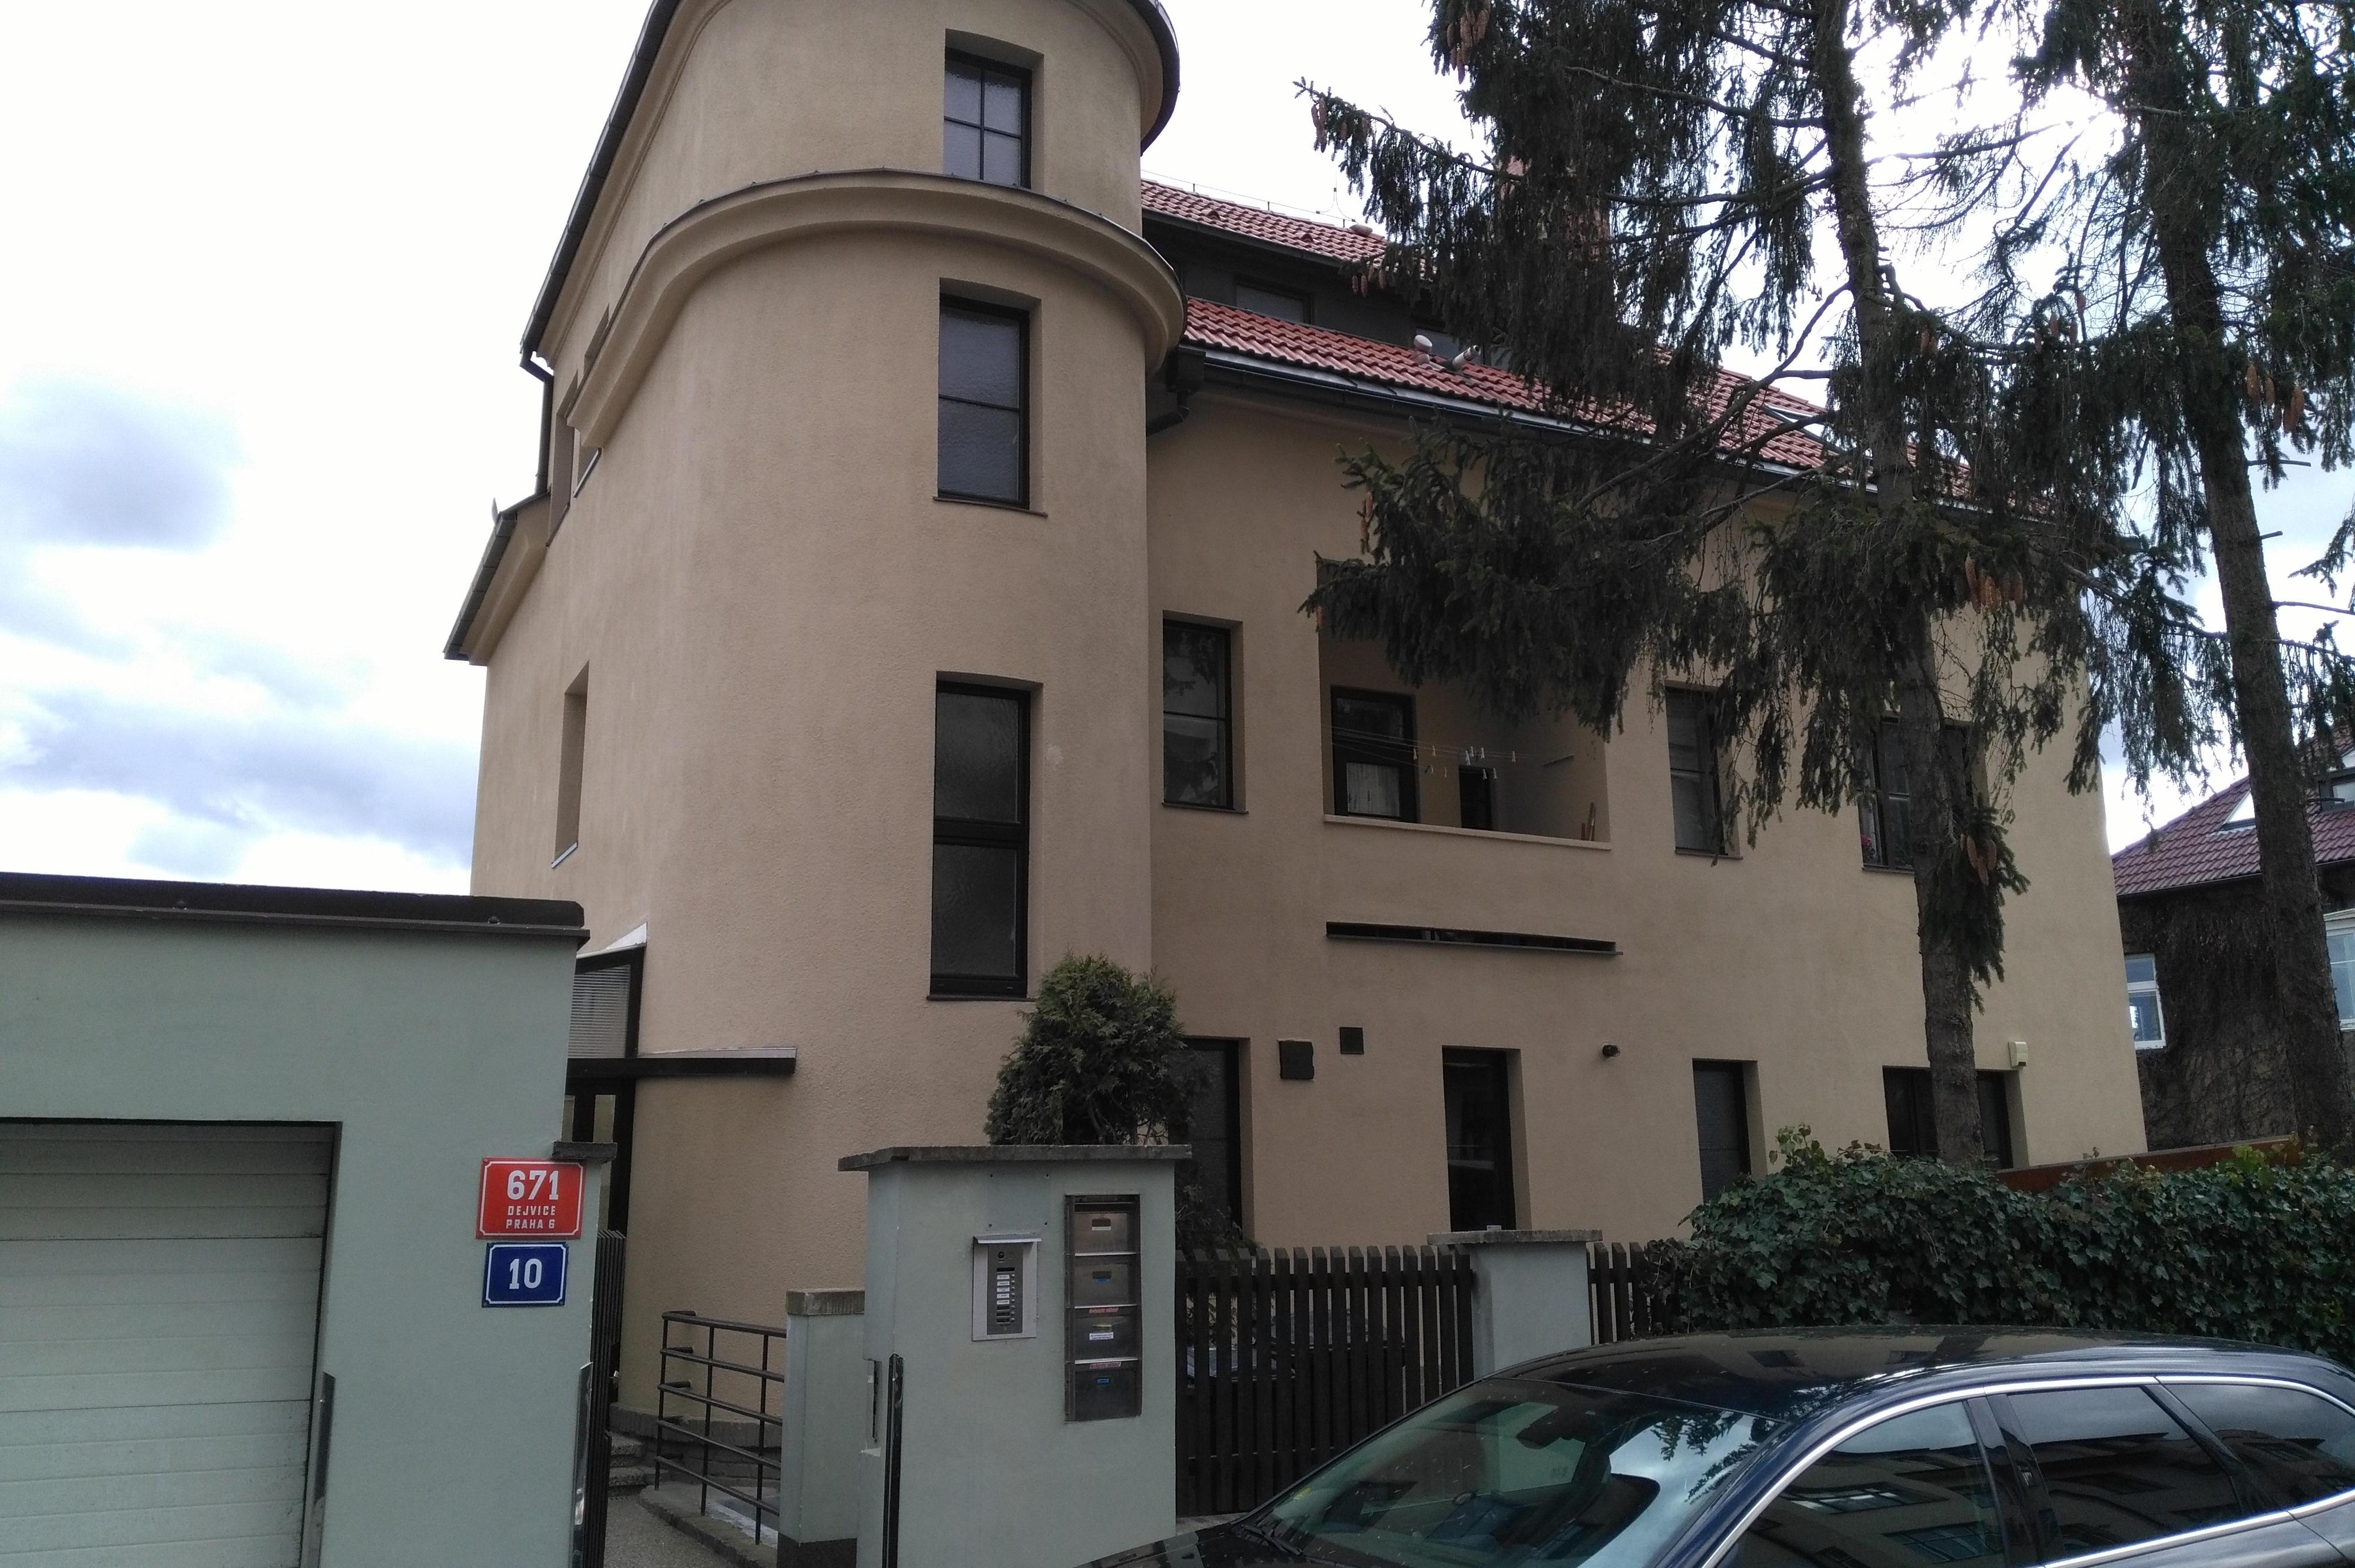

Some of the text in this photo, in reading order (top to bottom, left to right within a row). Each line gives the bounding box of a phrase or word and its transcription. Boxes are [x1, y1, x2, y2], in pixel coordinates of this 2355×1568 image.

[507, 1170, 559, 1201] 671
[508, 1205, 556, 1216] DEJVICE
[506, 1219, 555, 1229] PRAHA 6
[509, 1258, 542, 1290] 10
